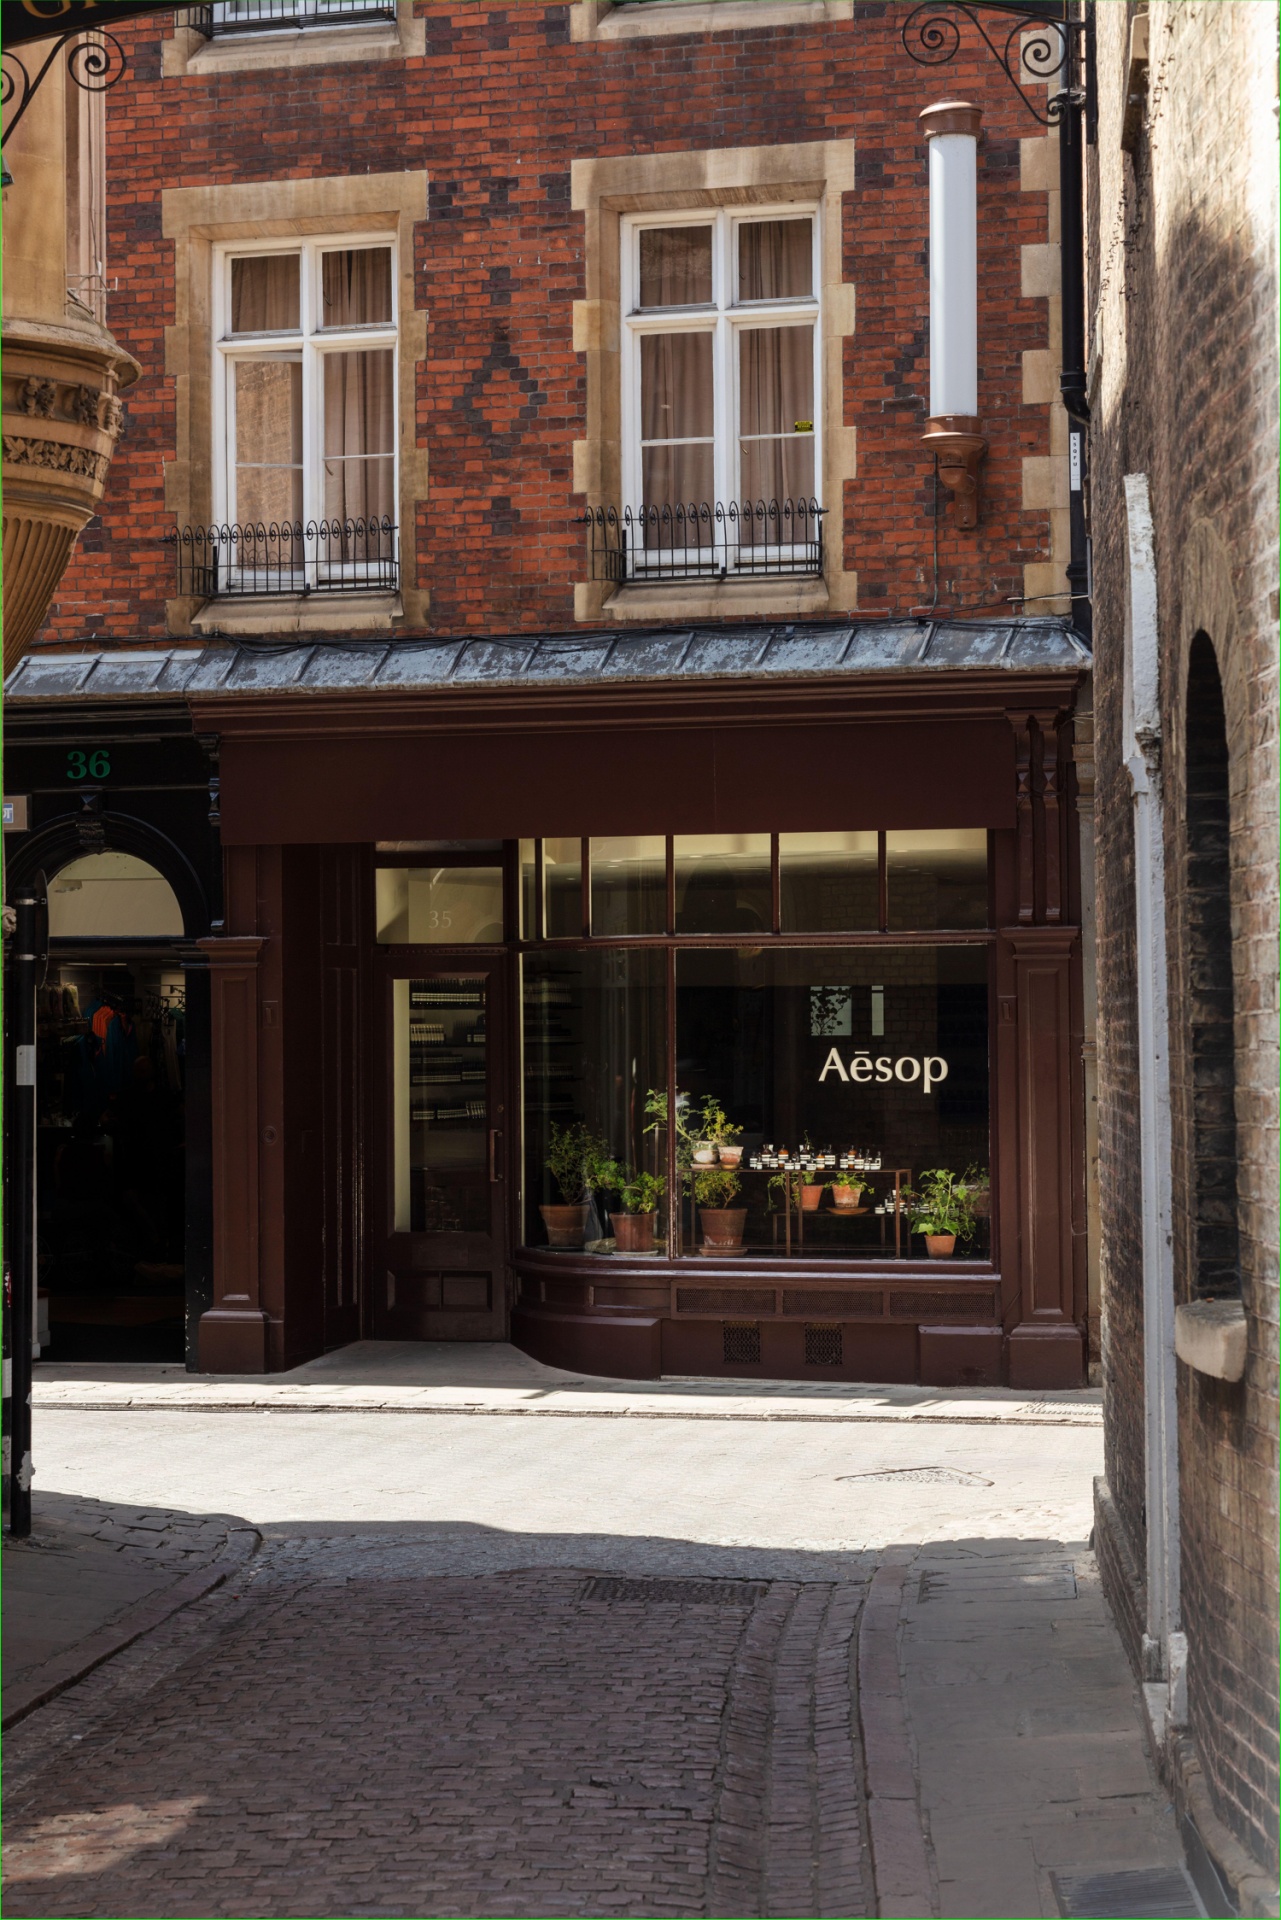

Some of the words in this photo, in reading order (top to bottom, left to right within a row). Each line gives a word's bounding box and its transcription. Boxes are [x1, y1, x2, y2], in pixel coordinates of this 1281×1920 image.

[66, 750, 111, 779] 36
[428, 910, 452, 929] 35
[818, 1047, 949, 1094] Aēsop
